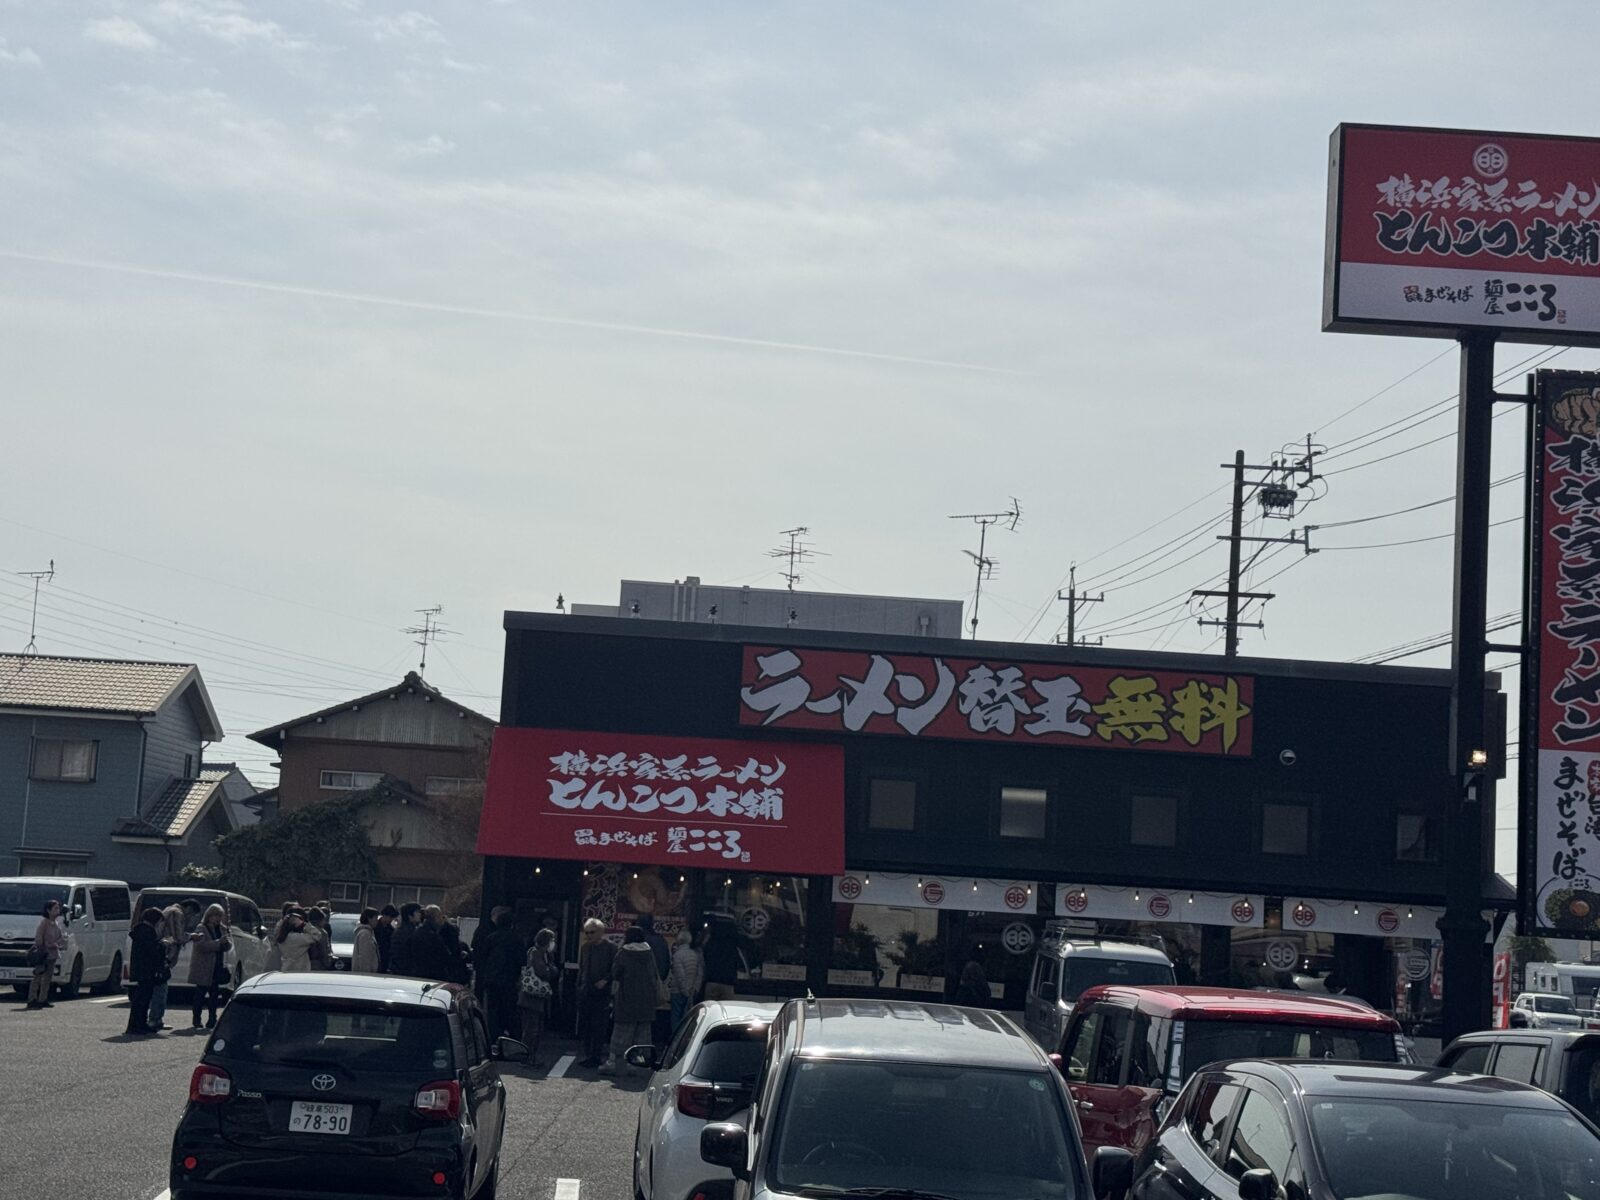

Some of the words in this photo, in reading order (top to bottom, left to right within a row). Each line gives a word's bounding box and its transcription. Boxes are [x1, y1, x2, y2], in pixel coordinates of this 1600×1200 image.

[740, 649, 1252, 755] ラーメン替玉無料
[548, 749, 788, 785] 横浜家系ラーメン
[546, 777, 784, 820] とんこつ本舗
[1553, 755, 1586, 880] まぜそば
[303, 1114, 348, 1131] 78-90
